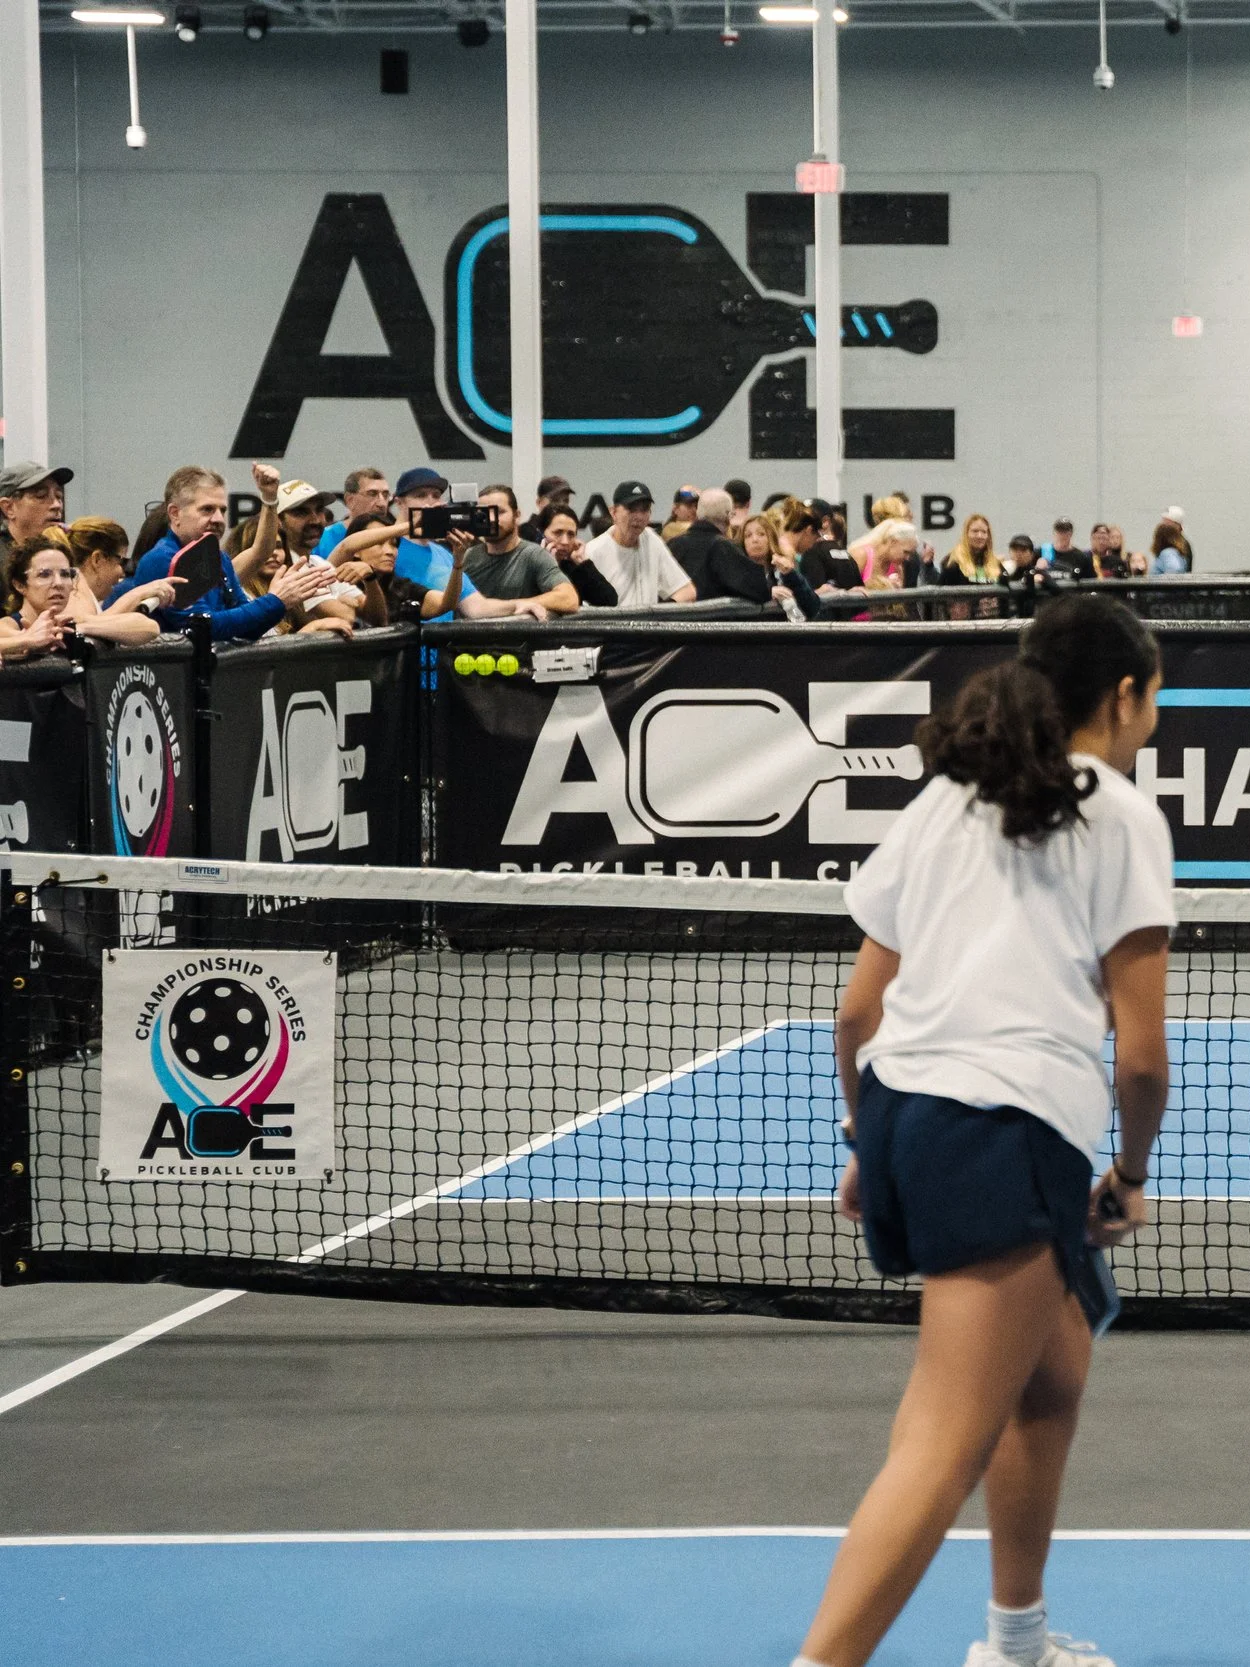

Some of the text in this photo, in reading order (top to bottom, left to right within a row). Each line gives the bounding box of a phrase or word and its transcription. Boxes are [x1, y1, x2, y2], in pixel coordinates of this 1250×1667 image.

[228, 193, 955, 459] ACE
[155, 686, 181, 778] SERIES
[245, 680, 371, 862] ACE
[501, 681, 931, 845] ACE
[185, 866, 220, 875] ACRYTECH
[135, 957, 306, 1042] CHAMPIONSHIP SERIES
[138, 1165, 296, 1175] PICKLEBALL CLUB
[139, 1102, 296, 1160] ACE
